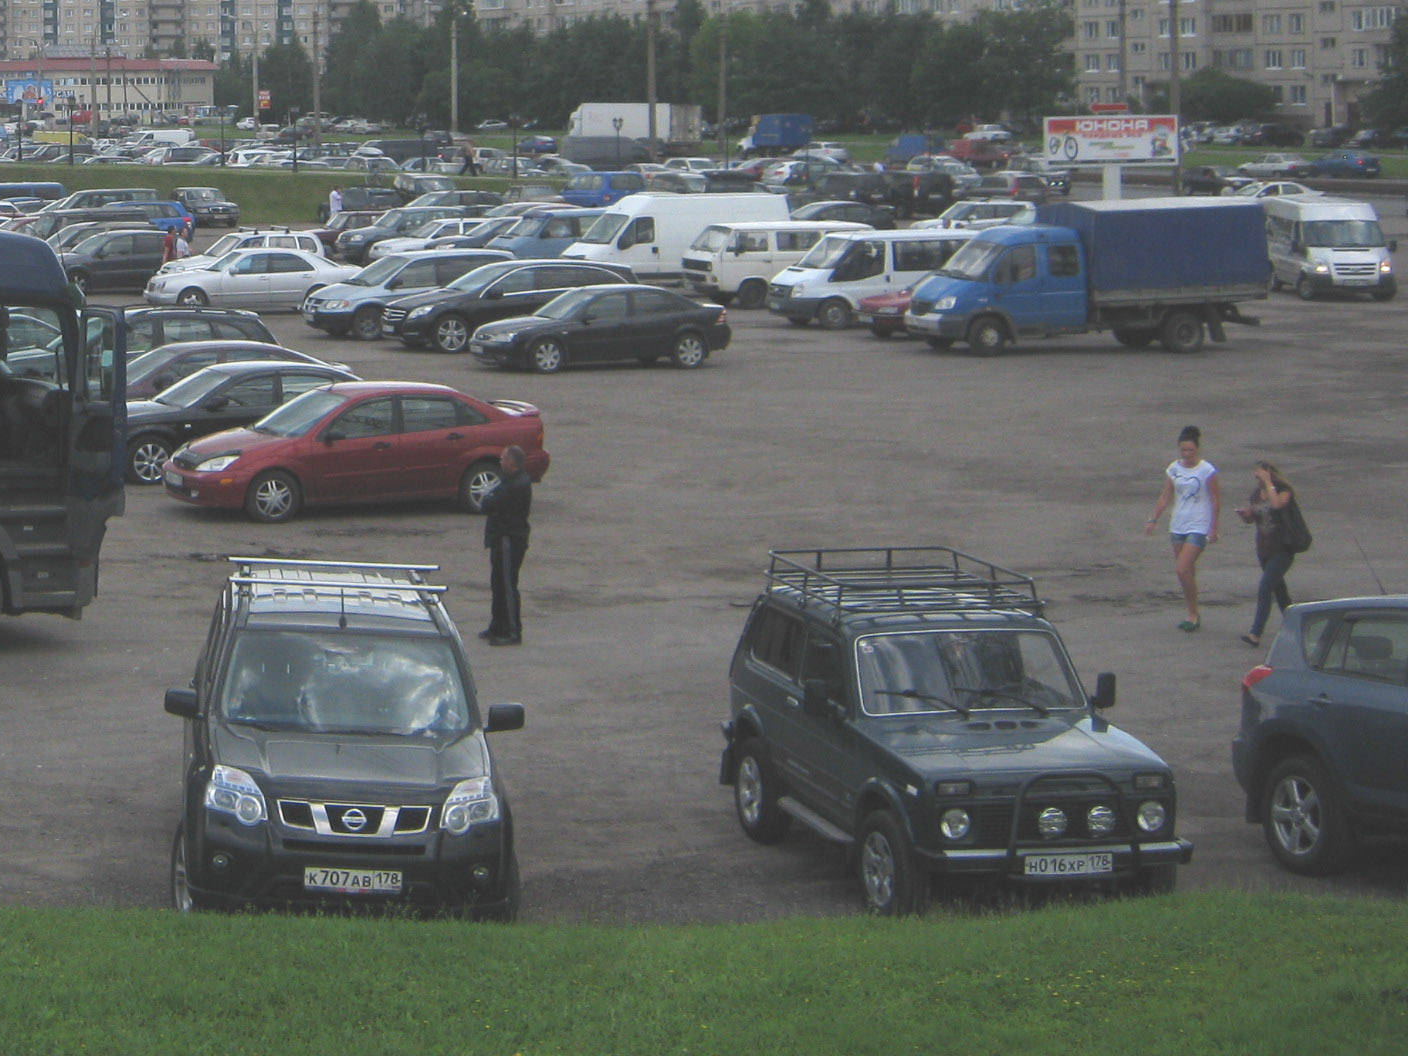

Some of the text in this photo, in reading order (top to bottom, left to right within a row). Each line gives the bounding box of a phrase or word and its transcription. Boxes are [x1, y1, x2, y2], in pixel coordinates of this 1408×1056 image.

[1077, 119, 1149, 132] ЮНОНА
[1089, 855, 1108, 867] 178
[374, 872, 398, 884] 178
